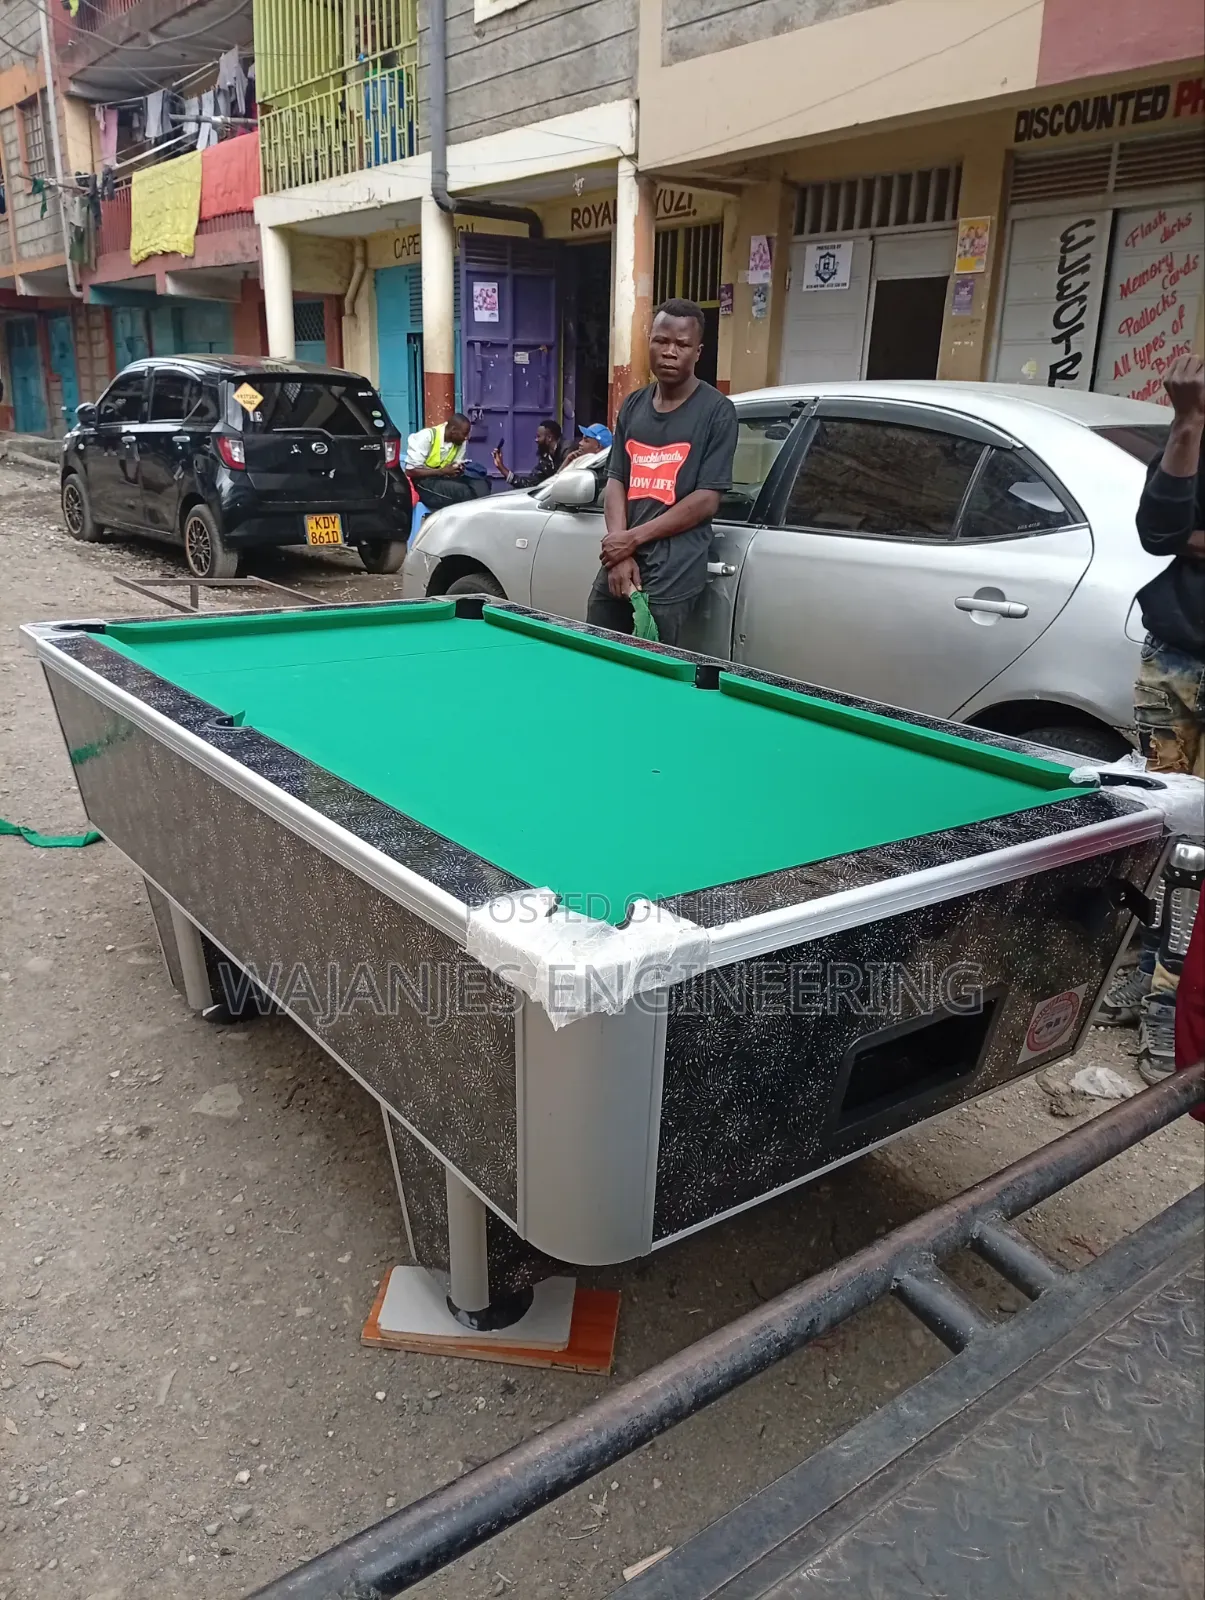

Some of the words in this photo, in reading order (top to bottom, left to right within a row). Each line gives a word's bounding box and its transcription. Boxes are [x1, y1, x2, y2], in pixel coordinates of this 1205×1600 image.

[1014, 84, 1170, 143] DISCOUNTED
[1173, 78, 1204, 118] PH
[1125, 210, 1167, 248] Flash
[1119, 252, 1174, 299] Memory
[1162, 254, 1199, 290] Cards
[1048, 218, 1096, 387] ELECTR
[1118, 290, 1177, 337] Padlocks
[1113, 356, 1131, 380] All
[1133, 331, 1166, 370] types
[1172, 304, 1185, 334] of
[630, 476, 651, 489] LOW
[652, 477, 675, 491] LIFE
[311, 530, 339, 545] 861D
[315, 516, 337, 530] KDY
